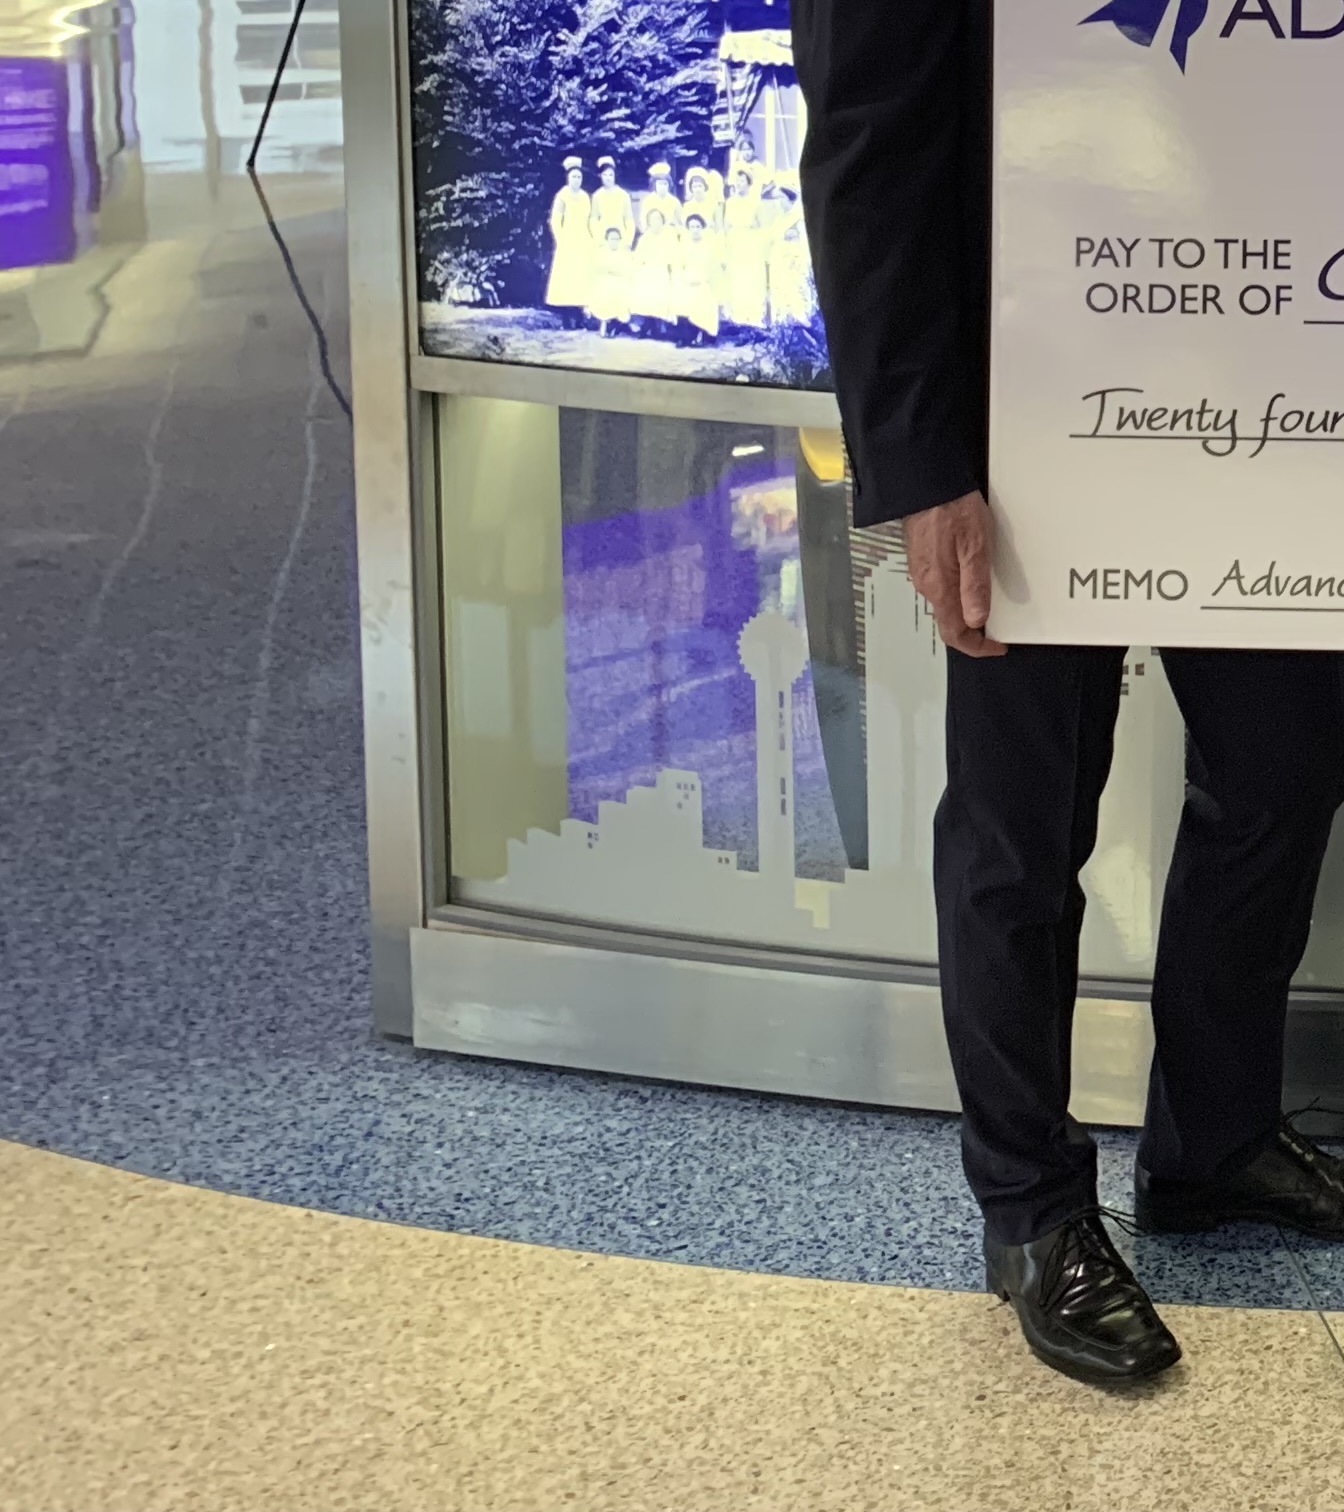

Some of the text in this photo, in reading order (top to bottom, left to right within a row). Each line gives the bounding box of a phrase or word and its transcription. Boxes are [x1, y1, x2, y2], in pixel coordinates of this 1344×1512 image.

[1076, 237, 1292, 270] PAY TO THE
[1086, 283, 1293, 316] ORDER OF
[1082, 387, 1238, 457] Twenty
[1069, 568, 1188, 601] MEMO
